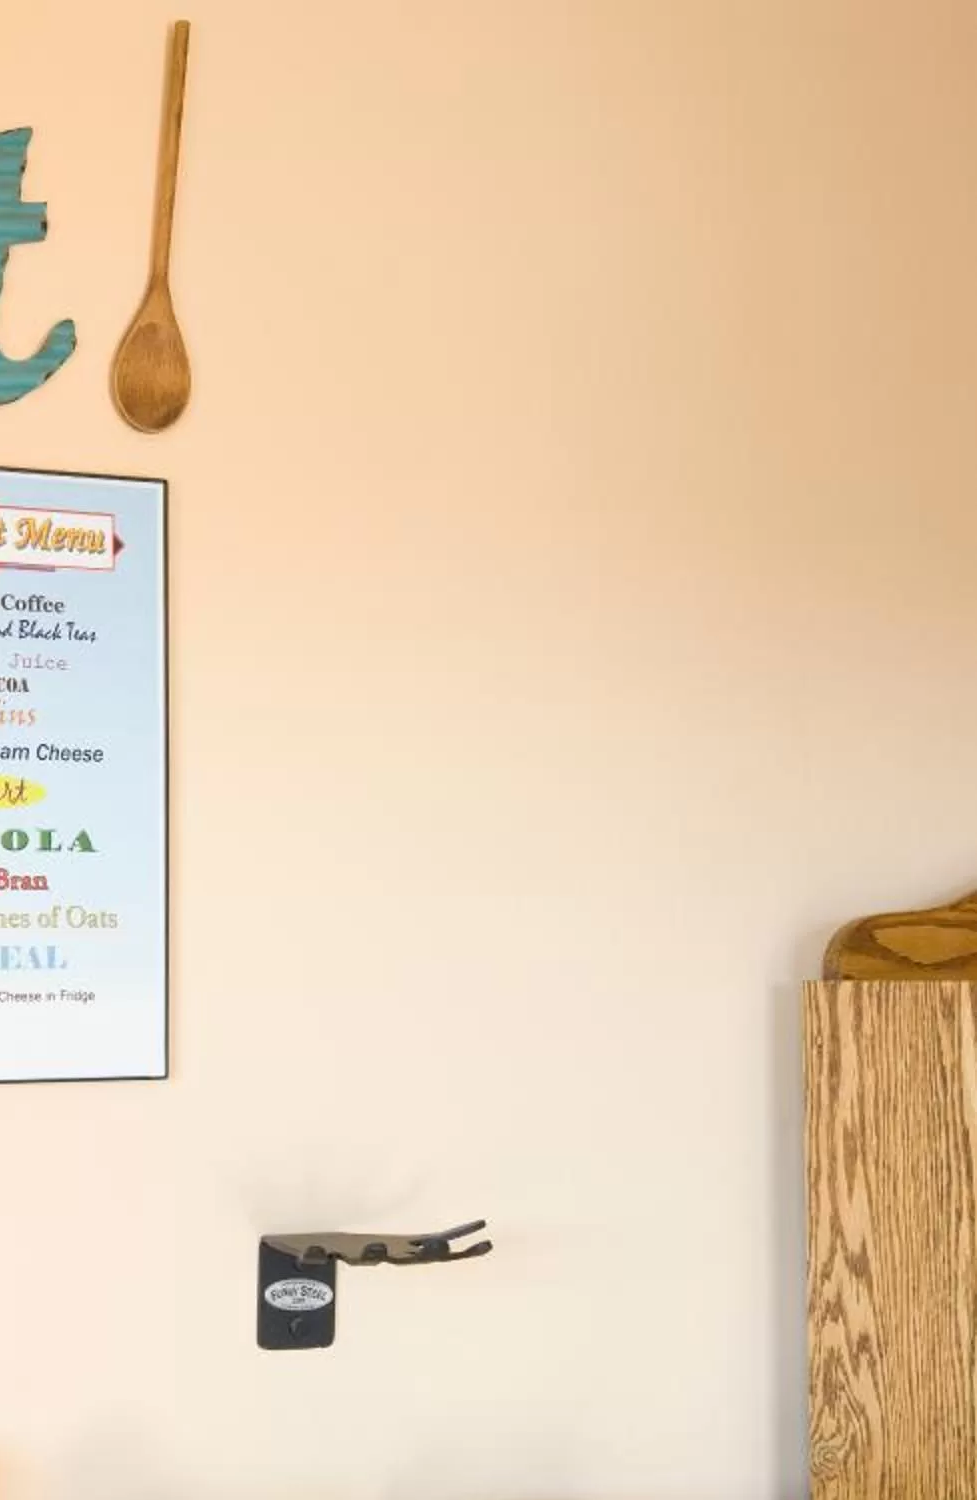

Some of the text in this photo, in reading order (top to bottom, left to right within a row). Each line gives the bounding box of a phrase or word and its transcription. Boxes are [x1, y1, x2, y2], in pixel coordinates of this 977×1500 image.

[15, 517, 106, 553] Menu
[1, 595, 65, 614] Coffee
[18, 620, 62, 642] Black
[66, 622, 98, 643] Teas
[8, 654, 69, 671] Juice
[35, 743, 104, 763] Cheese
[37, 905, 61, 929] of
[65, 907, 119, 930] Oats
[46, 991, 56, 1001] in
[60, 989, 96, 1004] Fridge
